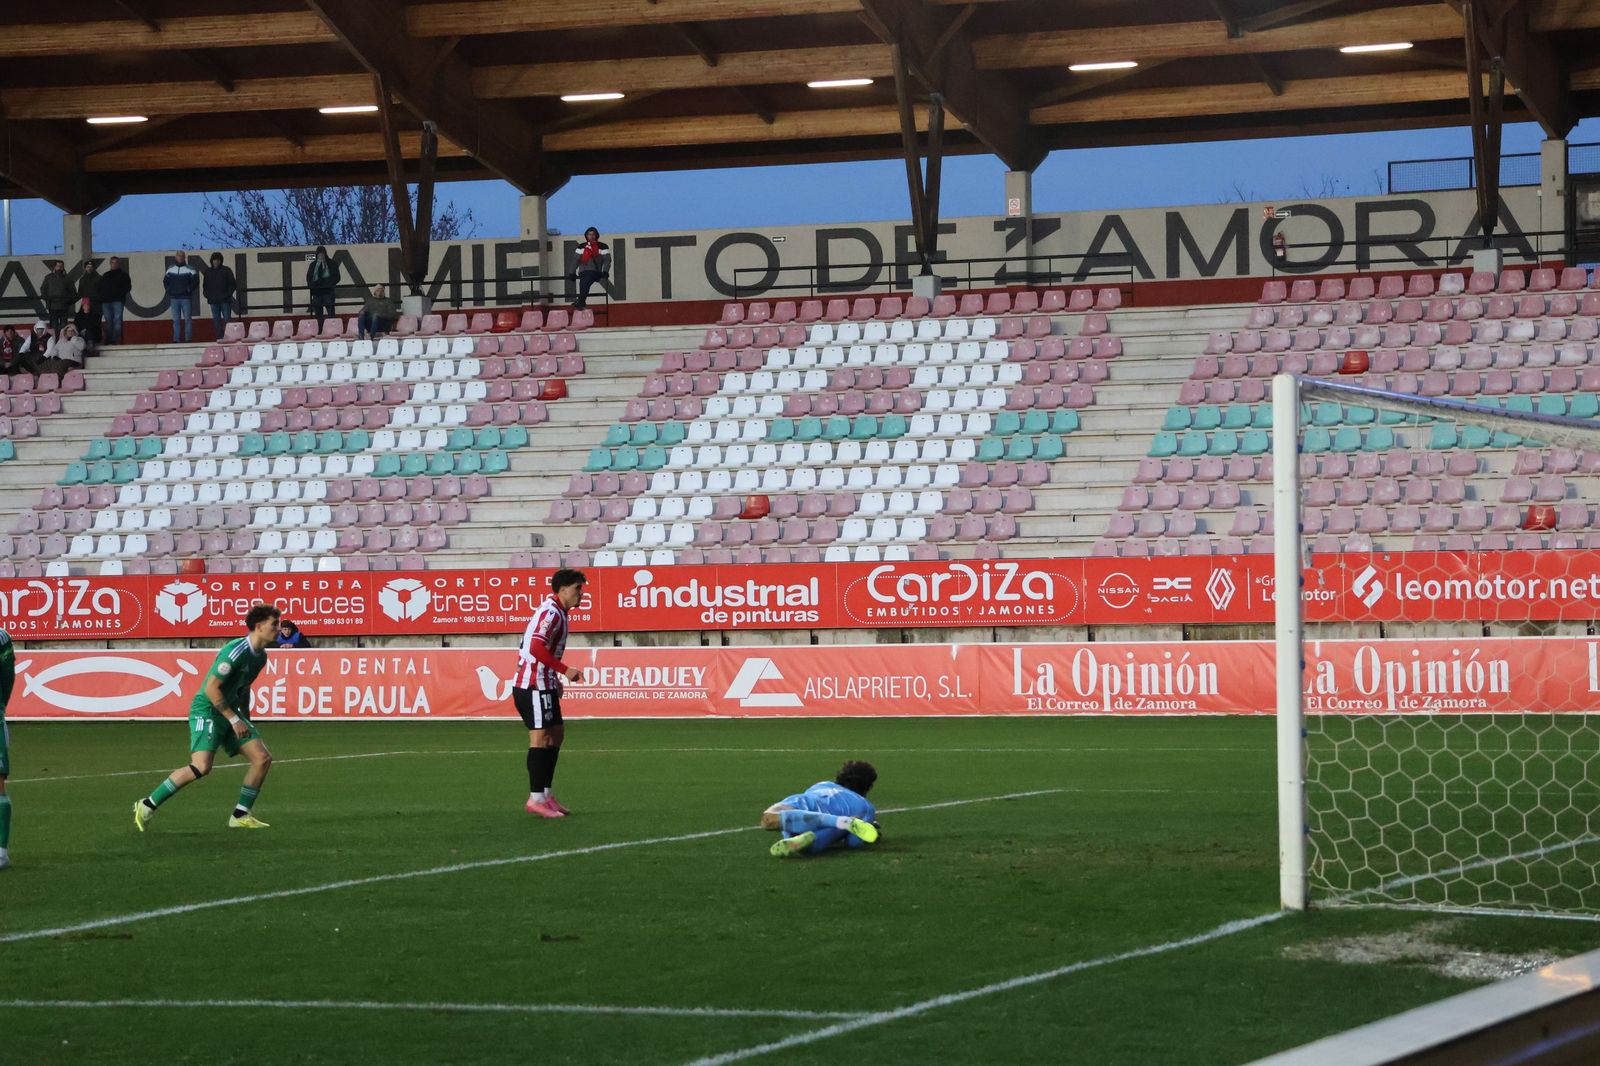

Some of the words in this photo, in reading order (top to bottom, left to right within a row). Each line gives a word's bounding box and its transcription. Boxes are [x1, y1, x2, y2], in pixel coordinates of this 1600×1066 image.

[816, 219, 957, 293] DE
[993, 195, 1538, 284] ZAMORA
[210, 579, 362, 592] ORTOPEDIA
[618, 593, 636, 608] la
[640, 576, 818, 608] industrial
[1098, 586, 1140, 595] NISSAN
[1395, 572, 1600, 601] leomotor.net
[274, 595, 365, 615] cruces
[432, 592, 490, 612] tres
[867, 606, 959, 617] EMBUTIDOS
[966, 605, 973, 615] Y
[979, 604, 1055, 615] JAMONES
[42, 619, 50, 629] Y
[54, 618, 122, 629] JAMONES
[208, 619, 234, 628] Zamora
[323, 617, 336, 626] 980
[432, 615, 458, 624] Zamora
[463, 615, 476, 623] 980
[486, 614, 495, 623] 53
[495, 614, 504, 623] 55
[701, 608, 728, 623] de
[732, 609, 819, 626] pinturas
[340, 657, 431, 675] DENTAL
[1012, 647, 1057, 697] La
[1072, 646, 1219, 713] Opinión
[1353, 645, 1511, 711] Opinión
[562, 691, 593, 700] ENTRO
[595, 691, 650, 700] COMERCIAL
[653, 691, 665, 700] DE
[667, 691, 708, 700] ZAMORA
[804, 675, 931, 701] AISLAPRIETO,
[938, 675, 973, 698] S.L.
[298, 685, 333, 714] DE
[344, 685, 430, 714] PAULA
[1026, 697, 1043, 710] El
[1045, 697, 1098, 711] Correo
[1113, 697, 1132, 710] de
[1135, 697, 1197, 710] Zamora
[1307, 696, 1323, 710] El
[1326, 696, 1383, 710] Correo
[1399, 696, 1418, 709] de
[1421, 696, 1487, 709] Zamora
